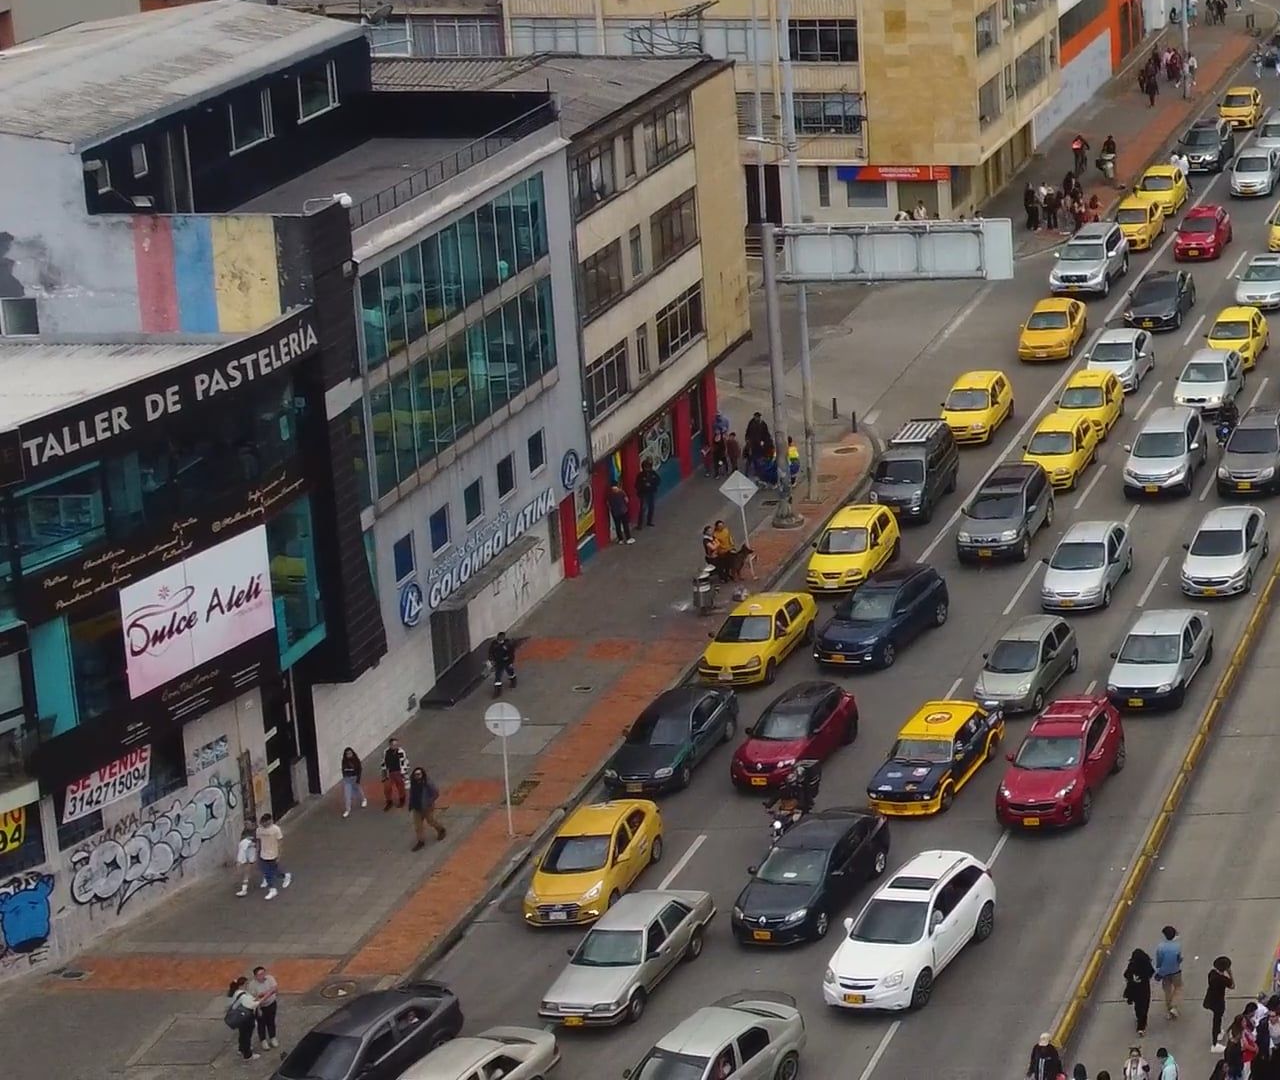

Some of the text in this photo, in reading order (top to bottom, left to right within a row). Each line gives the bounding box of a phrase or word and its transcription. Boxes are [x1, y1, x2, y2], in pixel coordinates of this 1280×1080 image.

[22, 320, 318, 467] TALLER DE PASTELERÍA
[429, 531, 503, 609] COLOMBO
[505, 488, 556, 546] LATINA
[126, 610, 199, 657] Dulce
[69, 764, 147, 816] 3142715094
[71, 747, 148, 795] SE VENDE
